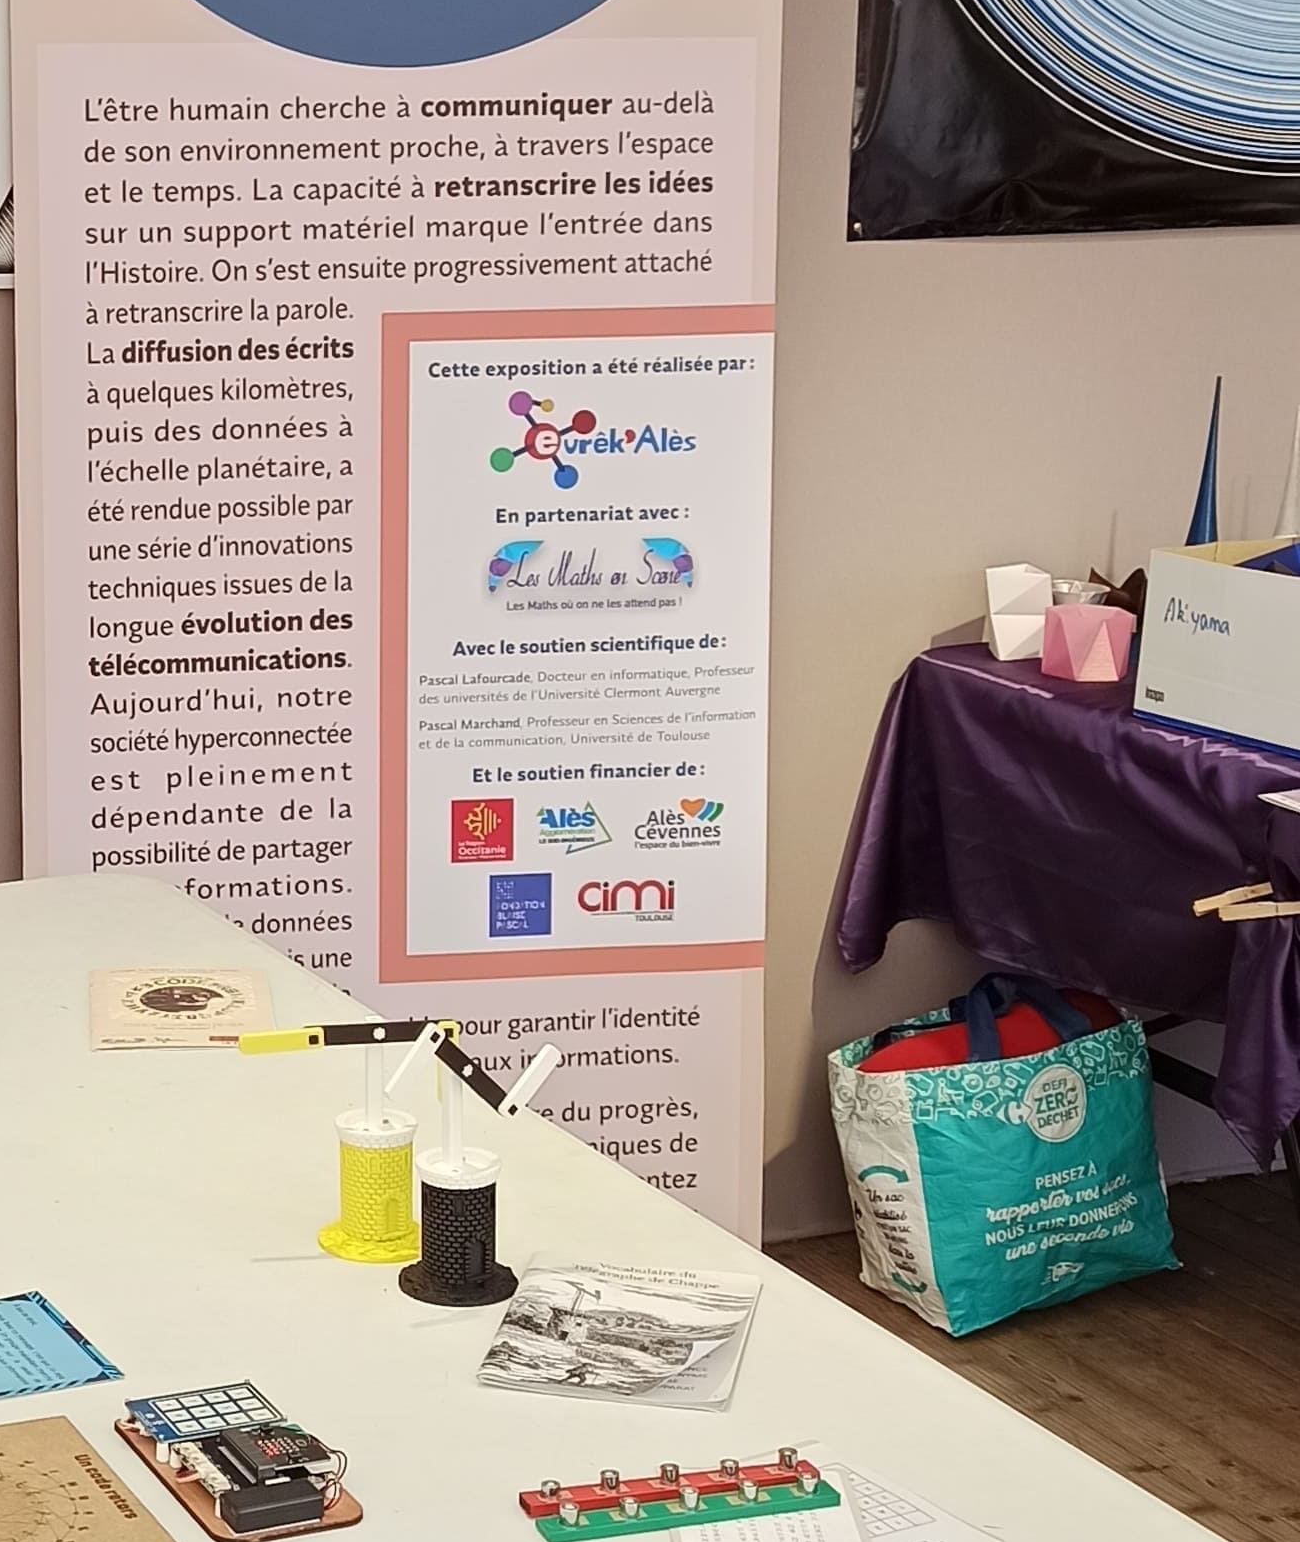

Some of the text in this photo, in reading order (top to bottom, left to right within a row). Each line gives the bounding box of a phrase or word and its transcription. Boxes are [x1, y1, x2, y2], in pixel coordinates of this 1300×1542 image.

[86, 91, 714, 121] L'être humain cherche à communiquer au-delà
[84, 131, 713, 164] de son environnement proche, à travers l'espace
[85, 170, 713, 208] et le temps. La capacité à retranscrire les idées
[86, 211, 712, 248] sur un support matériel marque l'entrée dans
[87, 249, 712, 283] l'Histoire. On s'est ensuite progressivement attaché
[428, 363, 480, 378] Cette
[486, 359, 586, 380] exposition
[592, 363, 602, 374] a
[608, 357, 638, 374] été
[644, 355, 712, 373] réalisée
[496, 509, 518, 523] En
[526, 505, 633, 527] partenariat
[639, 508, 679, 520] avec
[507, 551, 540, 587] Les
[548, 548, 601, 586] Maths
[506, 601, 524, 611] Les
[528, 601, 558, 610] Maths
[560, 600, 573, 609] où
[576, 601, 588, 609] on
[607, 599, 622, 608] les
[624, 598, 656, 608] attend
[658, 599, 676, 608] pas
[453, 641, 495, 656] Avec
[500, 640, 515, 654] le
[520, 638, 586, 654] soutien
[591, 635, 694, 654] scientifique
[88, 647, 351, 677] télécommunications.
[420, 674, 458, 686] Pascal
[538, 671, 586, 682] Docteur
[695, 666, 754, 677] Professeur
[419, 686, 720, 704] des universités de l'Université Clermont Auvergne
[419, 719, 457, 731] Pascal
[527, 716, 589, 727] Professeur
[612, 714, 663, 725] Sciences
[667, 713, 681, 723] de
[685, 711, 755, 722] l'information
[419, 740, 431, 749] et
[436, 737, 450, 749] de
[454, 737, 464, 747] la
[571, 732, 633, 744] Université
[638, 731, 652, 742] de
[656, 731, 710, 741] Toulouse
[473, 769, 492, 783] Et
[498, 767, 512, 782] le
[518, 765, 584, 781] soutien
[590, 763, 671, 779] financier
[540, 808, 596, 828] Alès
[647, 809, 685, 826] Alès
[634, 823, 722, 840] Cévennes
[458, 844, 506, 856] Occitanie
[578, 880, 675, 912] cimi
[636, 914, 674, 923] TOULOUSE
[508, 1010, 597, 1040] garantir
[602, 1005, 700, 1028] l'identité
[562, 1101, 590, 1122] du
[600, 1097, 698, 1125] progrès,
[1036, 1166, 1085, 1190] PENSEZ
[986, 1189, 1073, 1225] rapporter
[1076, 1186, 1099, 1203] vos
[985, 1223, 1025, 1246] NOUS
[1069, 1191, 1138, 1228] DONNERONS
[1006, 1218, 1134, 1261] une seconde vie
[573, 1263, 720, 1289] Télégraphe de Chappe
[600, 1262, 697, 1279] Vocabulaire du
